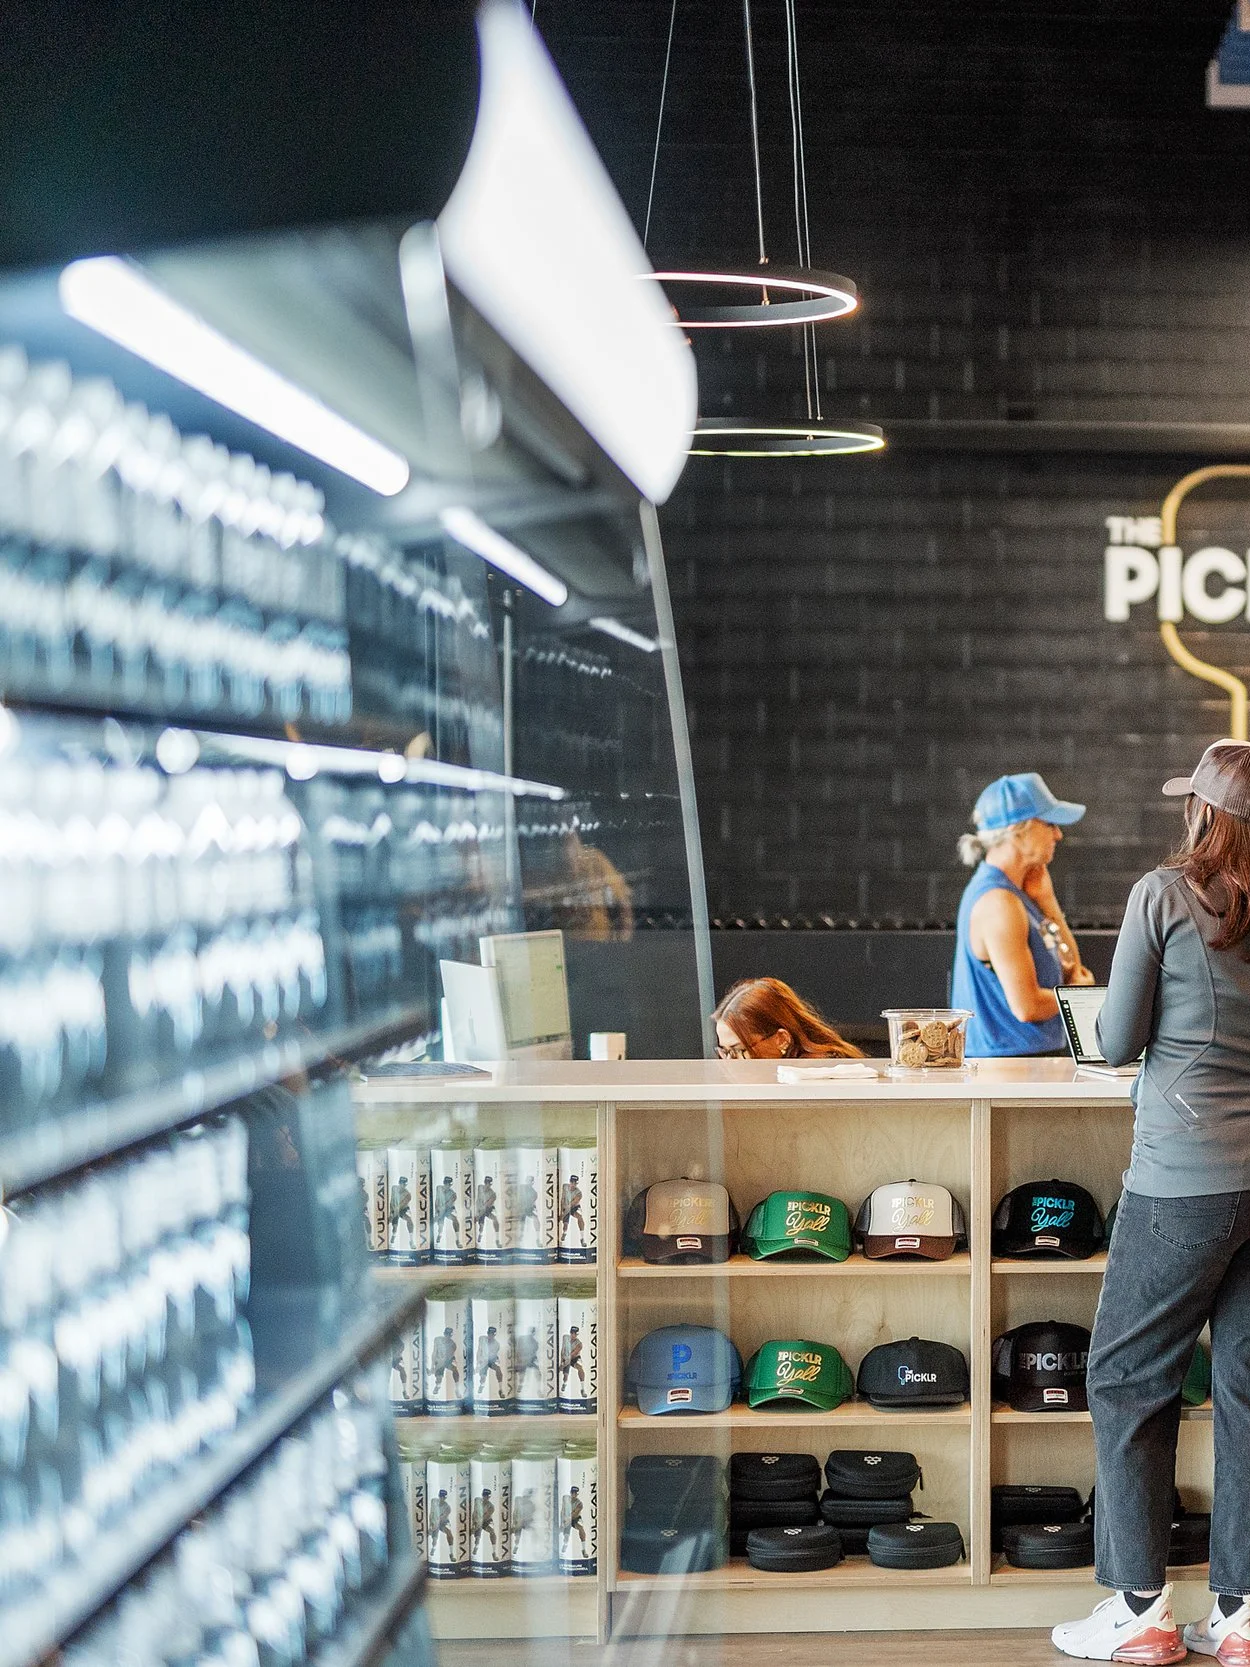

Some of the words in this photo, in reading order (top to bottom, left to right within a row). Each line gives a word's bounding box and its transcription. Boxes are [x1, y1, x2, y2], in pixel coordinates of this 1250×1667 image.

[1105, 516, 1162, 547] THE
[376, 1173, 386, 1248] VULCAN
[419, 1173, 428, 1247] VULCAN
[464, 1172, 473, 1247] VULCAN
[545, 1172, 554, 1246] VULCAN
[589, 1172, 598, 1245] VULCAN
[1036, 1196, 1076, 1211] PICKLR
[546, 1323, 555, 1397] VULCAN
[590, 1323, 598, 1396] VULCAN
[905, 1373, 937, 1383] PICKLR
[415, 1485, 425, 1559] VULCAN
[458, 1486, 467, 1560] VULCAN
[501, 1485, 509, 1559] VULCAN
[589, 1482, 598, 1556] VULCAN
